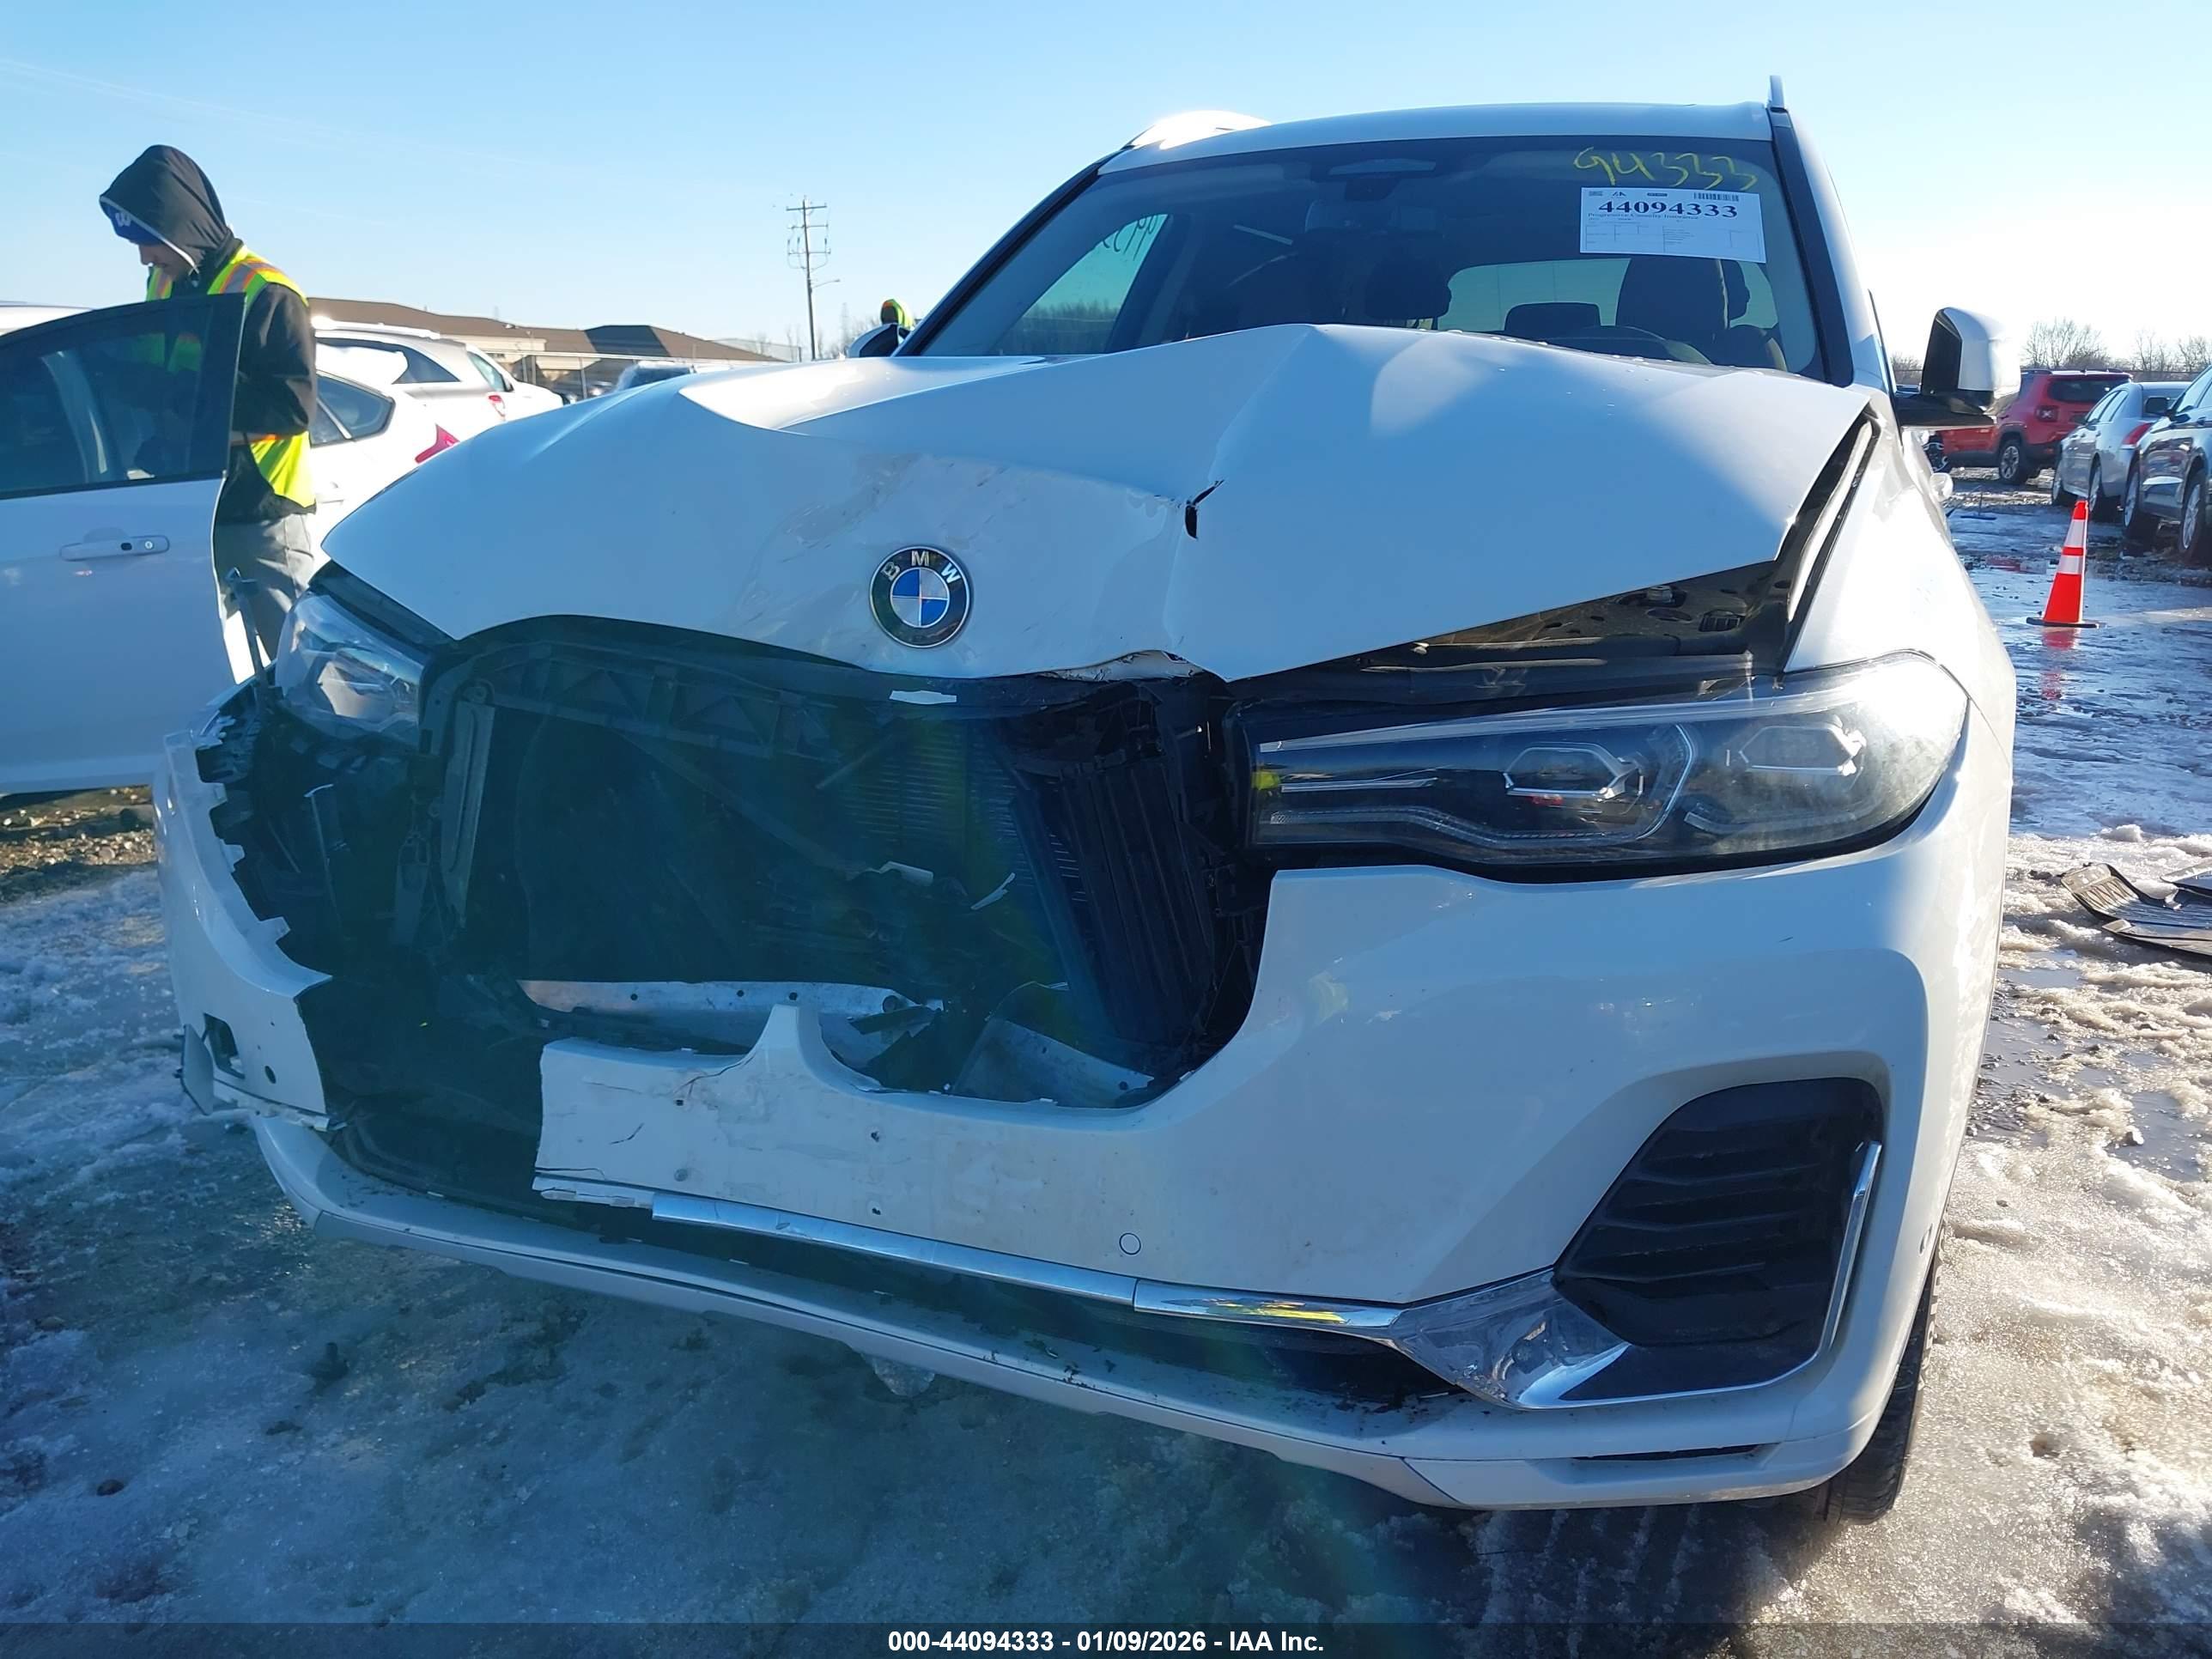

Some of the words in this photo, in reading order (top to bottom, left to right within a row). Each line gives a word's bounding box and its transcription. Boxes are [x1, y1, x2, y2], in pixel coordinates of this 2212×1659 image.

[1573, 146, 1759, 191] 94333
[1598, 201, 1738, 218] 44094333
[881, 550, 961, 584] BMW
